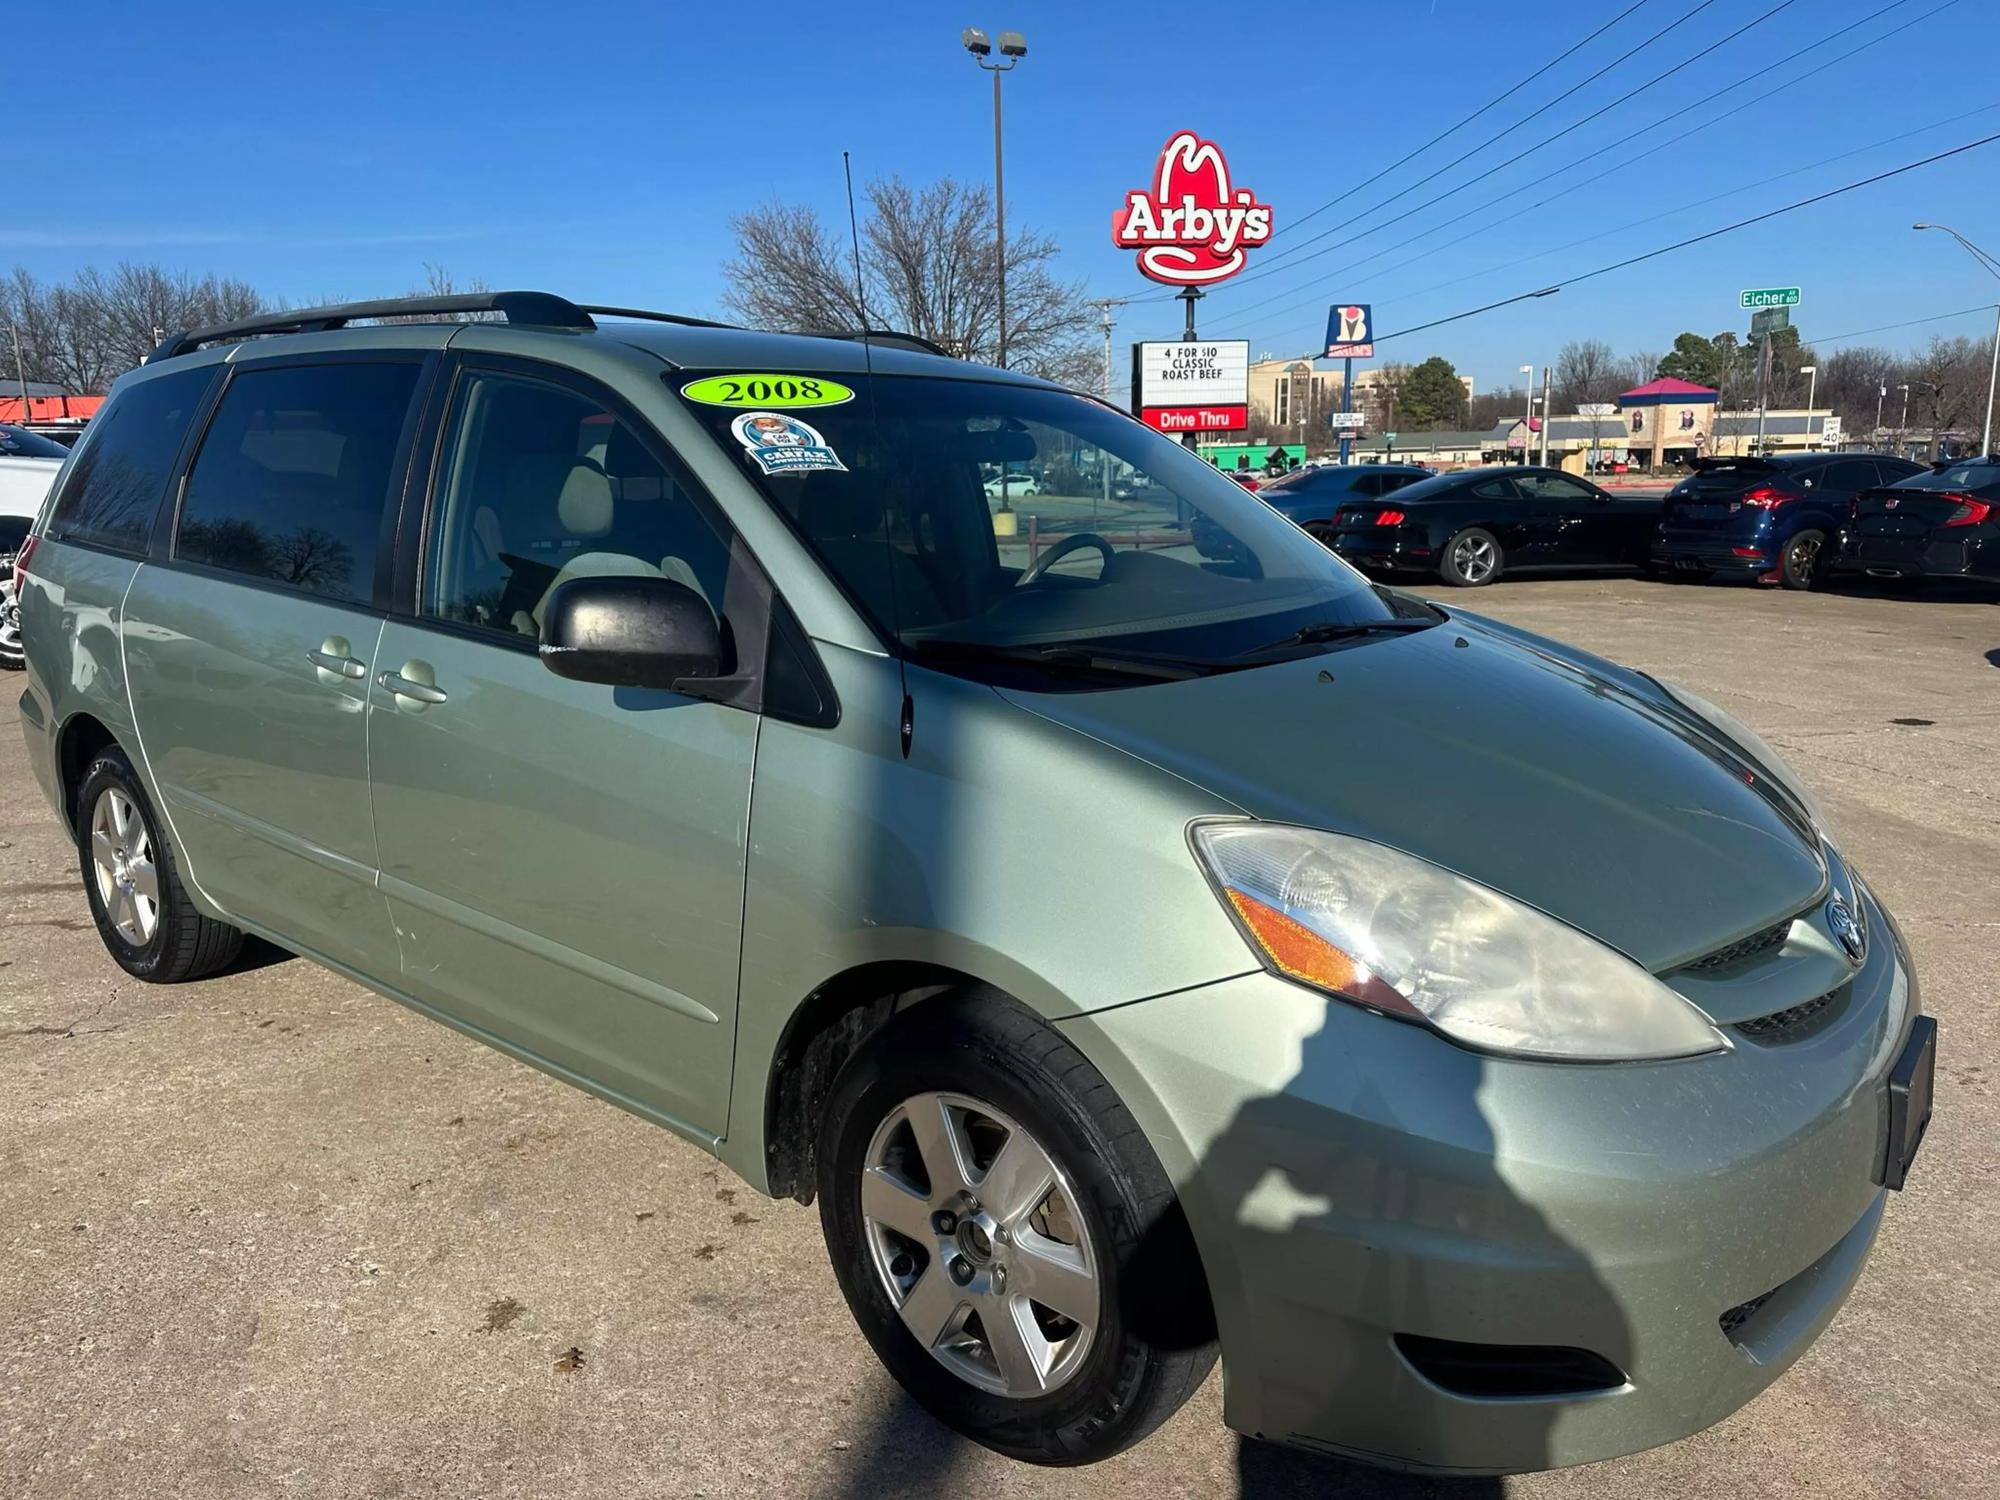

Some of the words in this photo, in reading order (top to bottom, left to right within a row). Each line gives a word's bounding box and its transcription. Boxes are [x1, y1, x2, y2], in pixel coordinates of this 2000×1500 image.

[1121, 193, 1270, 253] Arby's
[1743, 291, 1785, 306] Eicher
[1164, 348, 1171, 358] 4
[1177, 347, 1198, 358] FOR
[1201, 347, 1218, 357] $10
[1172, 358, 1214, 369] CLASSIC
[1162, 370, 1196, 380] ROAST
[1199, 369, 1223, 379] BEEF
[719, 380, 823, 401] 2008
[1160, 412, 1195, 428] Drive
[1198, 411, 1230, 426] Thru
[1824, 432, 1838, 443] 40
[763, 451, 828, 460] CARFAX
